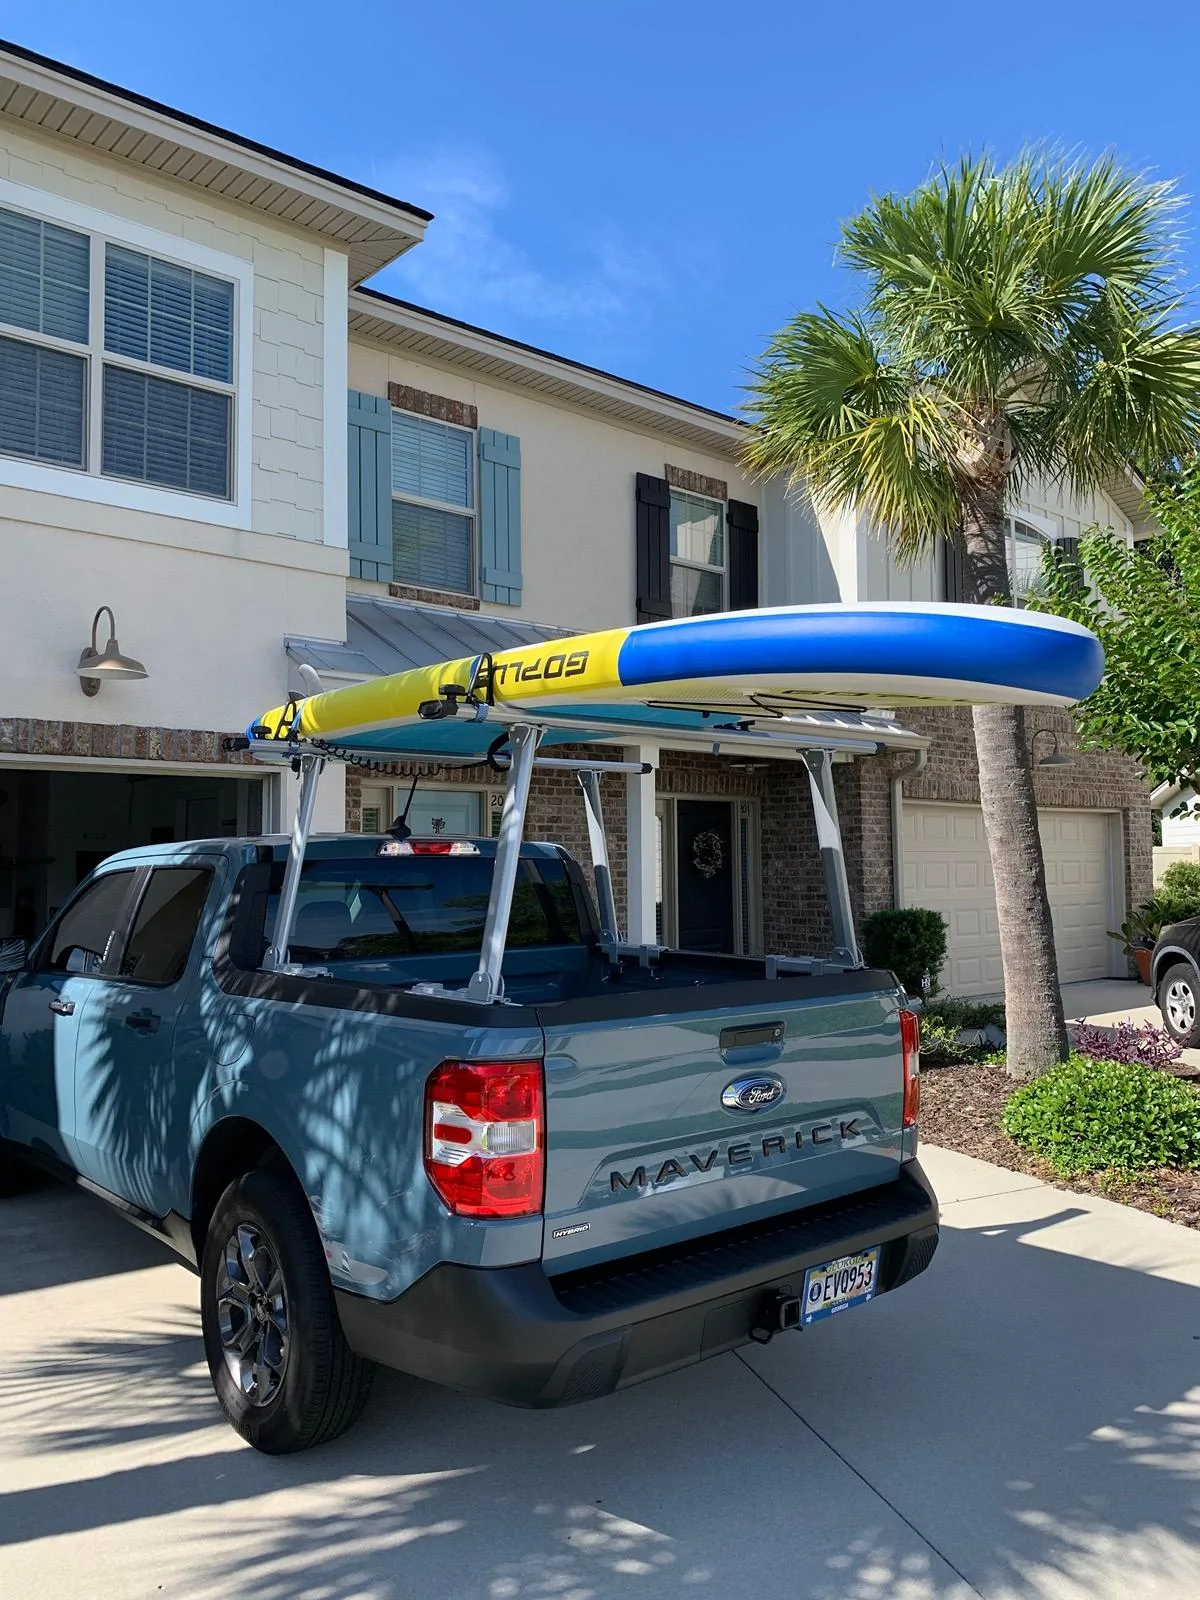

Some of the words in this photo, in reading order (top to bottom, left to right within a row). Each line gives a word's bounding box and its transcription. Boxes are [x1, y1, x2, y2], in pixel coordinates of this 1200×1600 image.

[748, 1086, 775, 1103] Ford
[609, 1117, 863, 1192] MAVERICK
[556, 1224, 589, 1238] HYBRID
